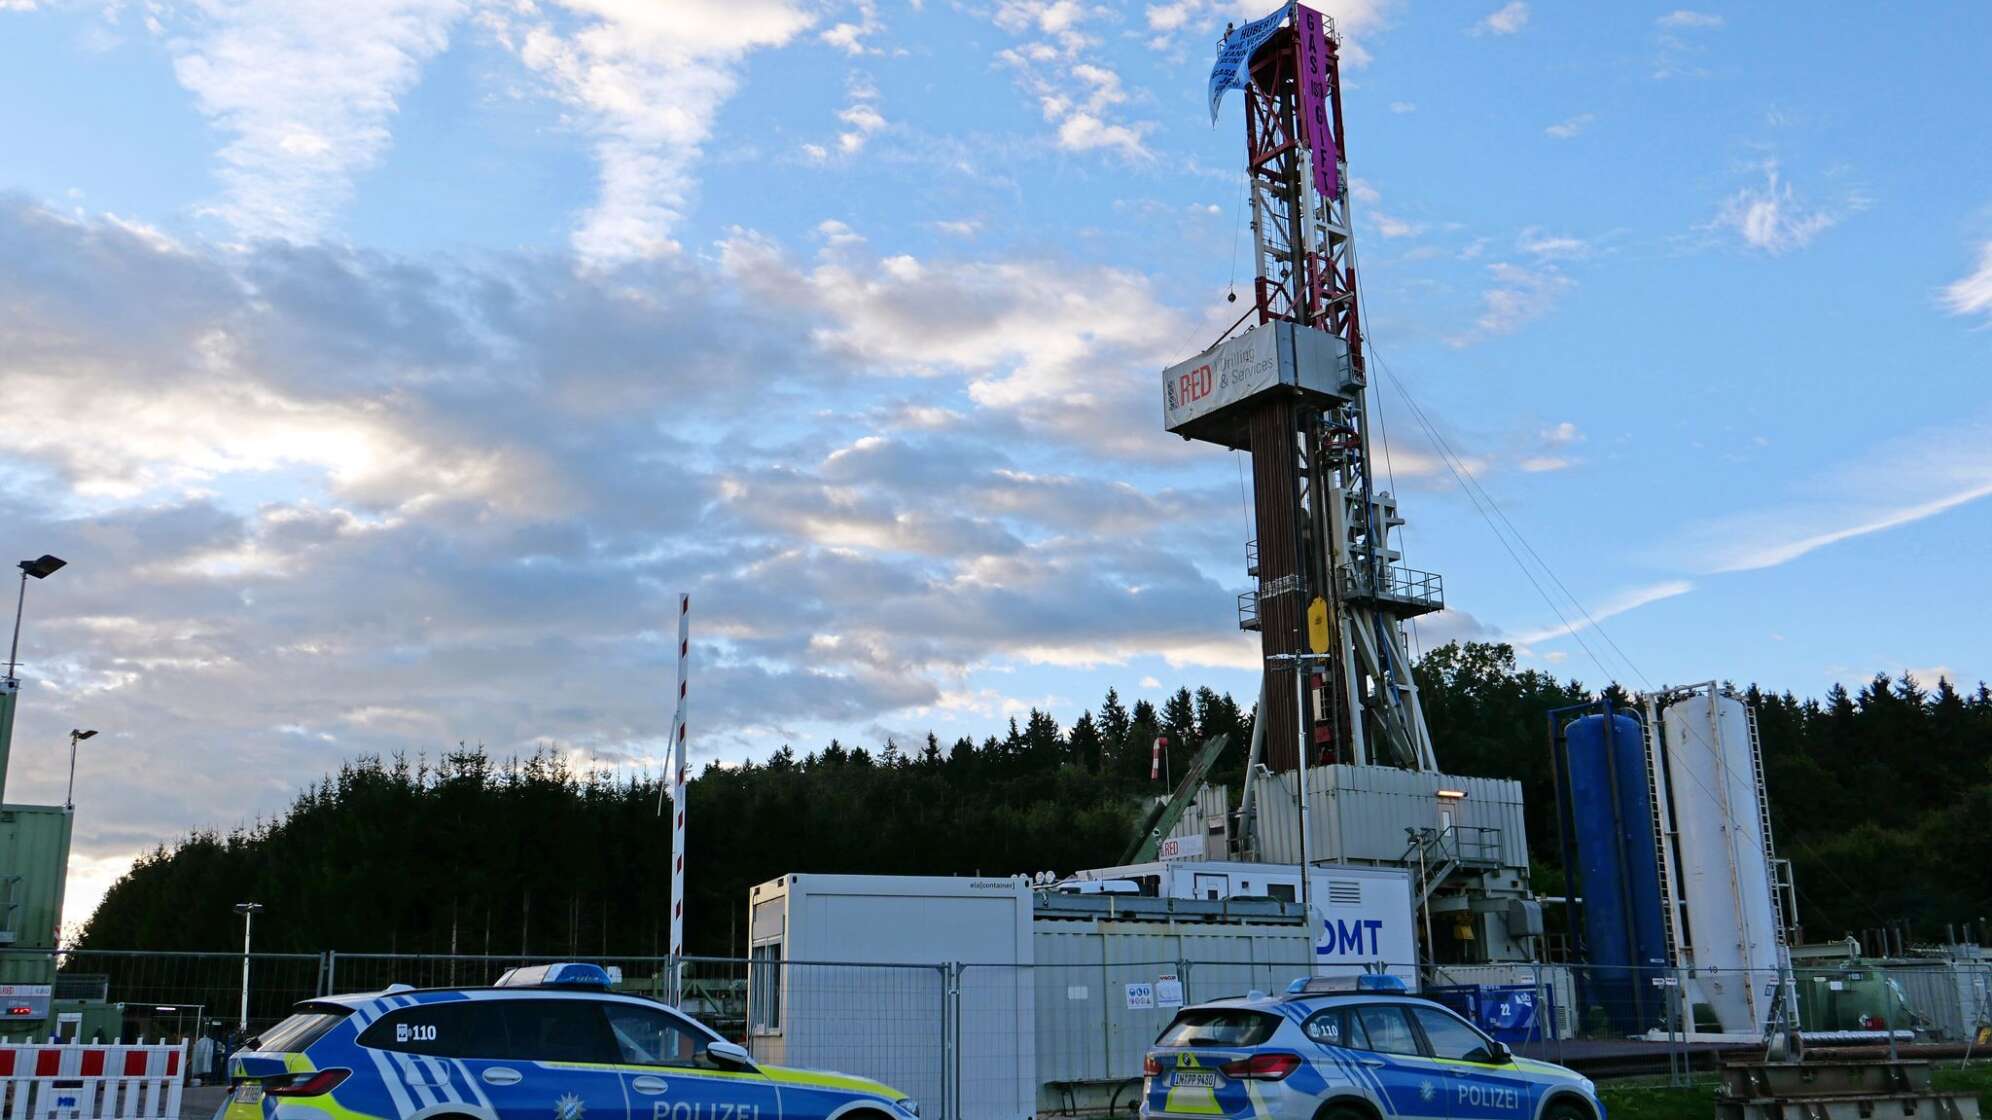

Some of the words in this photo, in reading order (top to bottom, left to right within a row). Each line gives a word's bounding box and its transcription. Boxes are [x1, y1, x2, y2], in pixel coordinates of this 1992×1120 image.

[1306, 14, 1317, 75] GAS
[1315, 105, 1328, 191] GIFT
[1179, 364, 1212, 407] RED
[1220, 373, 1230, 389] &
[1231, 358, 1273, 385] Services
[1164, 841, 1179, 857] RED
[1316, 919, 1383, 955] DMT
[1500, 1003, 1511, 1016] 22
[412, 1024, 437, 1041] 110
[1320, 1024, 1339, 1037] 110
[1458, 1084, 1519, 1110] POLIZEI
